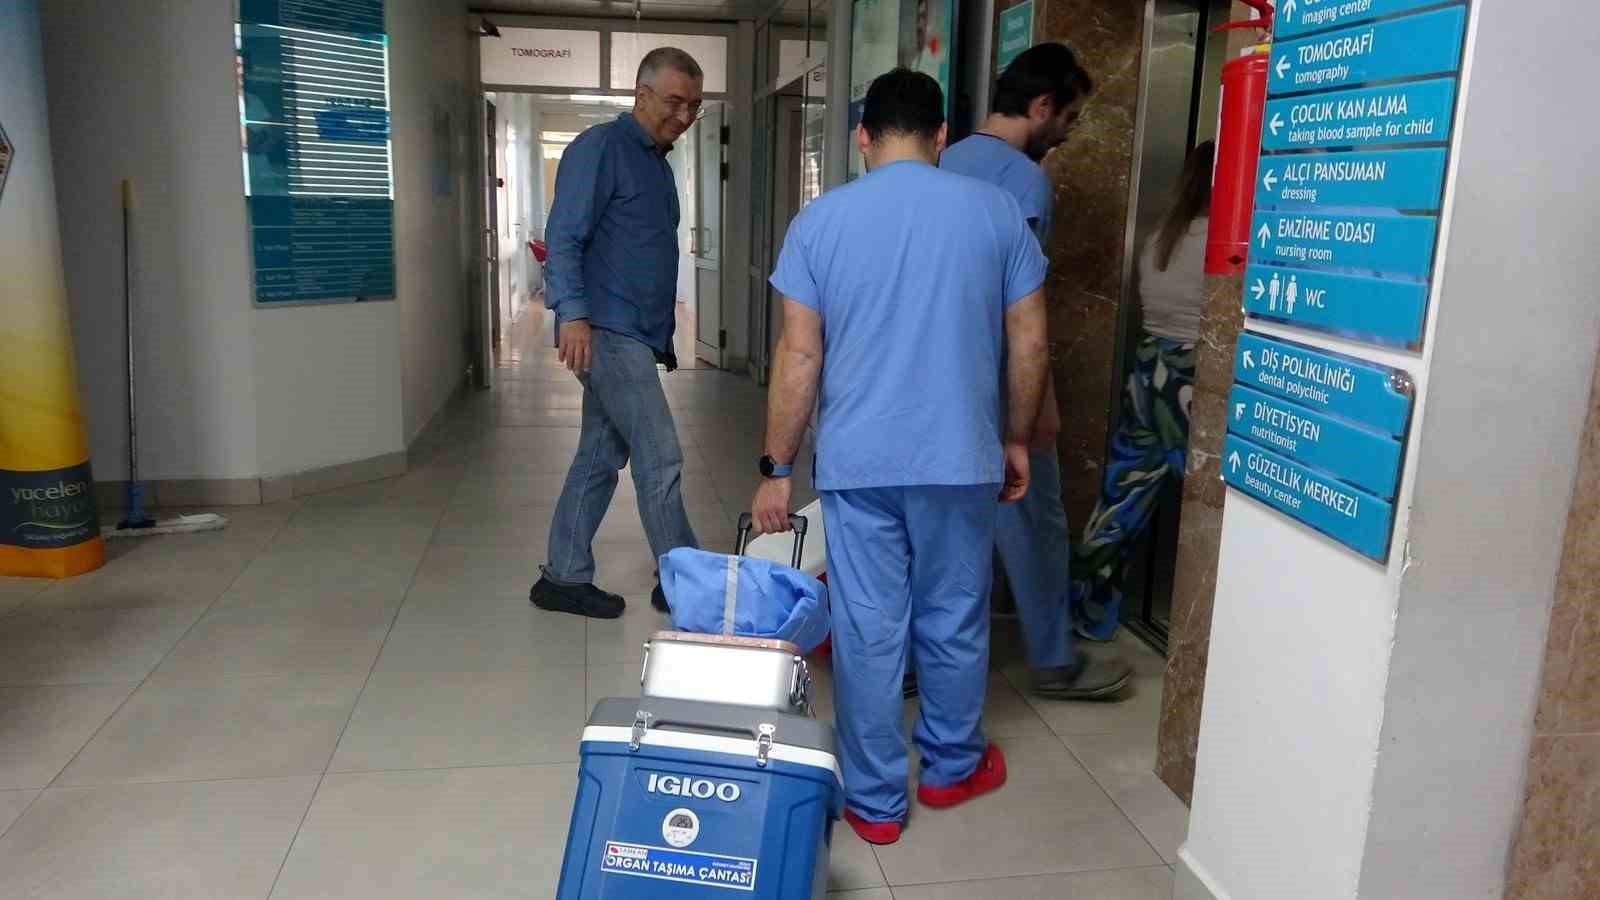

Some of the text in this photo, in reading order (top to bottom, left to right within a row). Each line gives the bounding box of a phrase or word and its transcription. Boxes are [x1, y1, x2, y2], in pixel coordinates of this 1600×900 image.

[1302, 0, 1372, 25] imaging center
[1298, 28, 1375, 65] TOMOGRAFİ
[1295, 64, 1349, 84] tomography
[1290, 93, 1408, 127] ÇOCUK KAN ALMA
[1288, 117, 1433, 144] taking blood sample for child
[1283, 161, 1386, 185] ALÇI PANSUMAN
[1281, 187, 1317, 202] dressing
[1278, 215, 1376, 244] EMZİRME ODASI
[1275, 244, 1333, 261] nursing room
[1305, 287, 1327, 309] WC
[1260, 348, 1279, 372] DİŞ
[1258, 371, 1330, 404] dental polyclinic
[1253, 401, 1320, 443] DİYETİSYEN
[1251, 424, 1298, 452] nutritionist
[1245, 473, 1302, 509] beauty center
[1247, 452, 1360, 519] GÜZELLİK MERKEZİ
[648, 773, 741, 802] IGLOO
[605, 854, 650, 871] ORGAN
[653, 861, 695, 877] TAŞIMA
